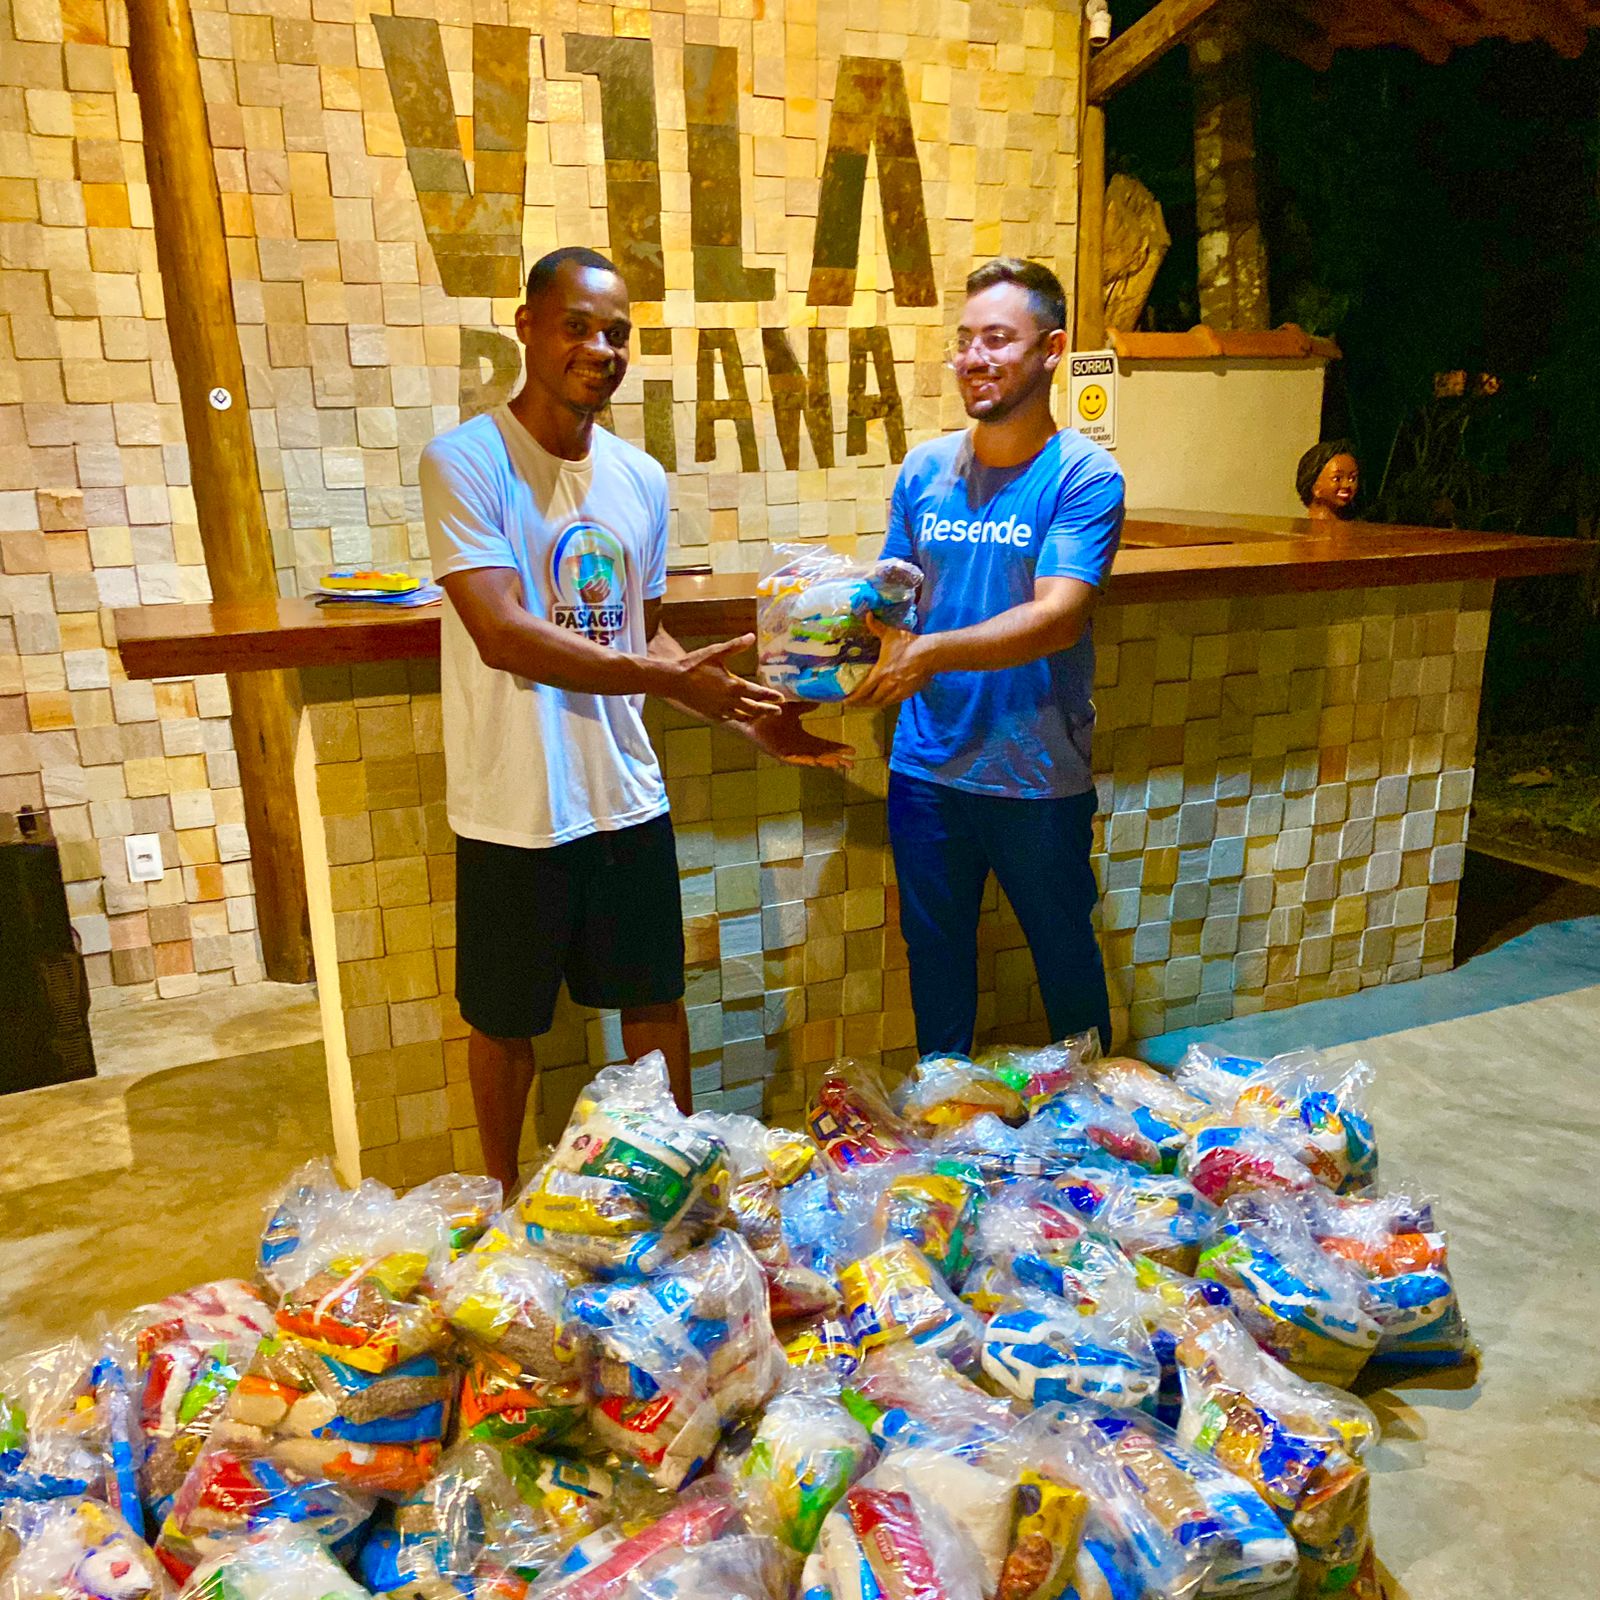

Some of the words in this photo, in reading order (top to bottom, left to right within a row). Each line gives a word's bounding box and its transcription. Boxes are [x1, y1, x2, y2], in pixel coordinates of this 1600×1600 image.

[371, 15, 938, 306] VILA
[1073, 360, 1112, 375] SORRIA
[921, 513, 1033, 547] Resende
